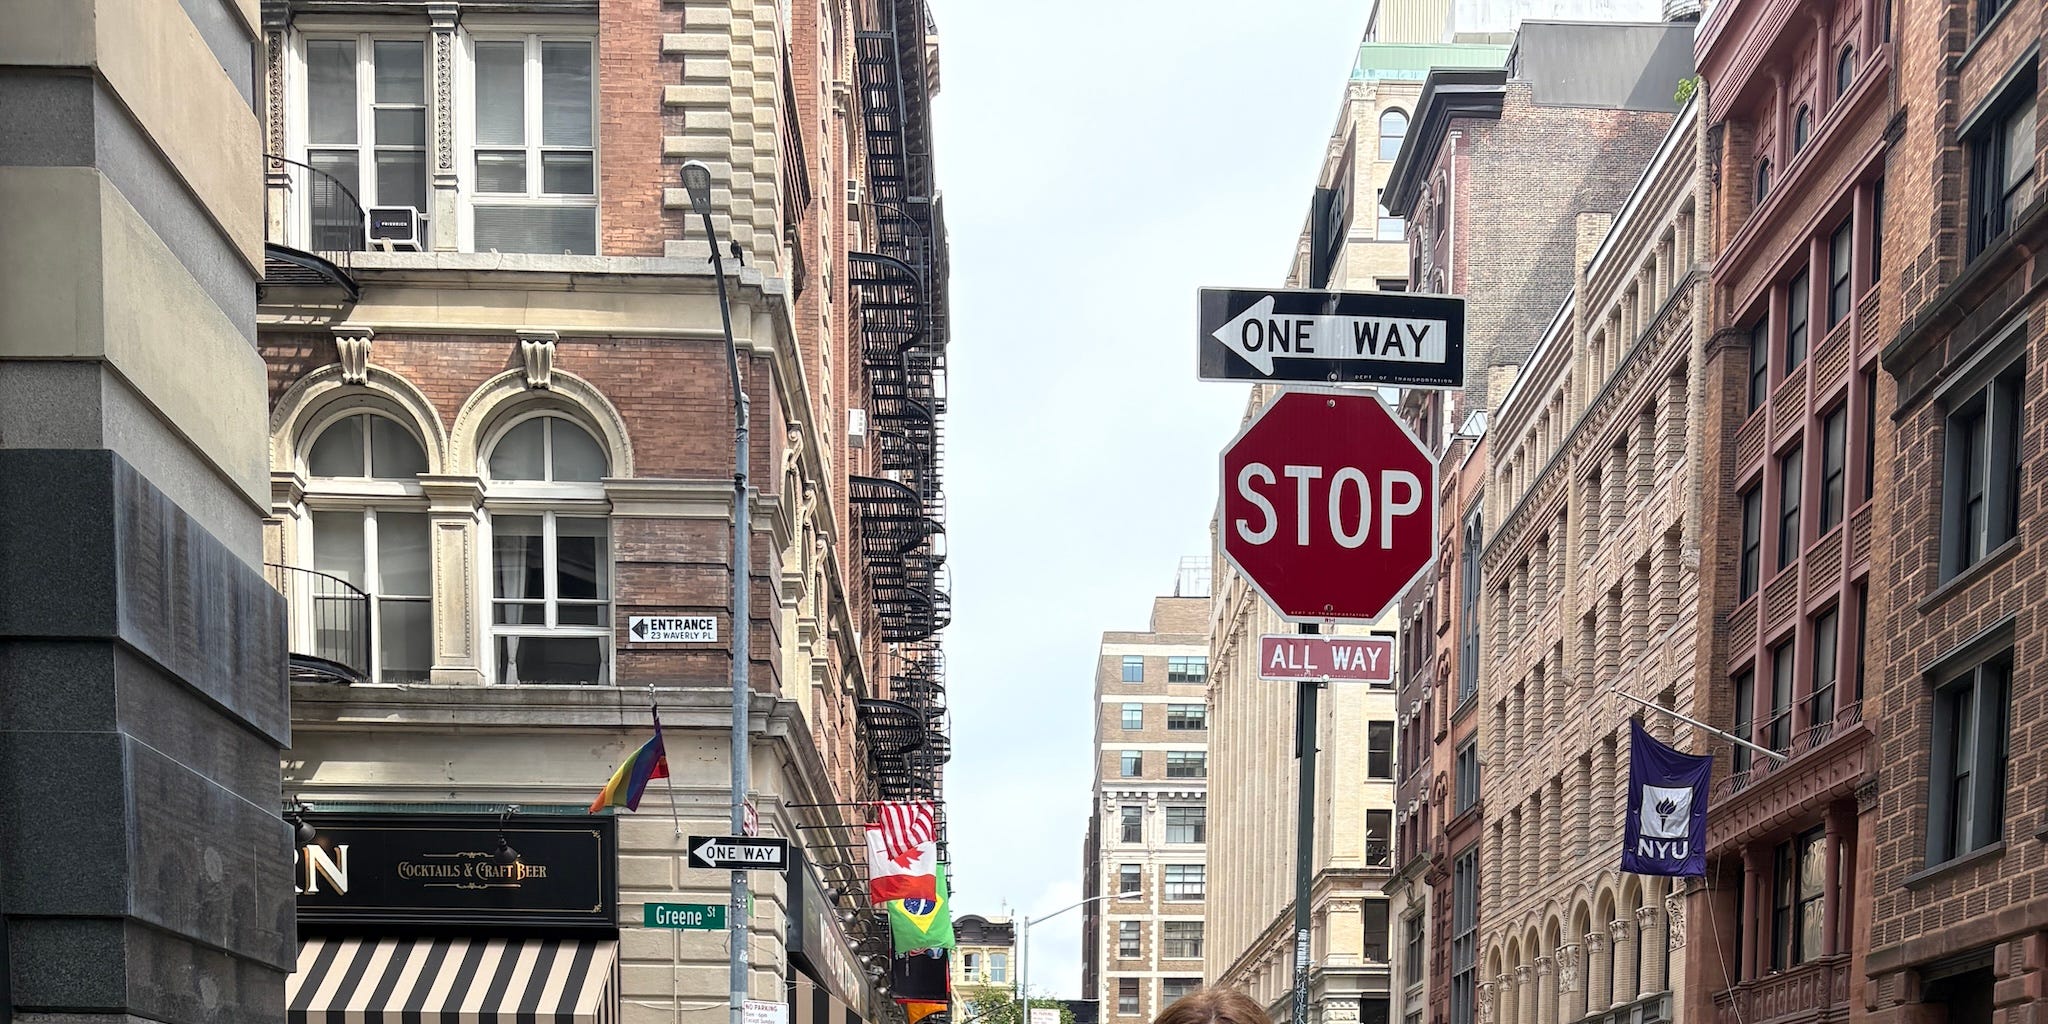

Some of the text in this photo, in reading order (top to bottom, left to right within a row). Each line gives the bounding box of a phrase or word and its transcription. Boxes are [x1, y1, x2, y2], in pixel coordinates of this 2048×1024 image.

[1242, 318, 1431, 358] ONE WAY
[1394, 376, 1453, 384] TRANSPORTATION
[1235, 462, 1423, 550] STOP
[650, 619, 713, 630] ENTRANCE
[651, 631, 661, 639] 23
[663, 631, 699, 639] WAVERLY
[1270, 644, 1382, 672] ALL WAY
[706, 846, 774, 860] ONE WAY
[1637, 838, 1689, 860] NYU
[463, 863, 474, 877] &
[656, 905, 716, 926] Greene St
[745, 1003, 778, 1012] NO PARKING
